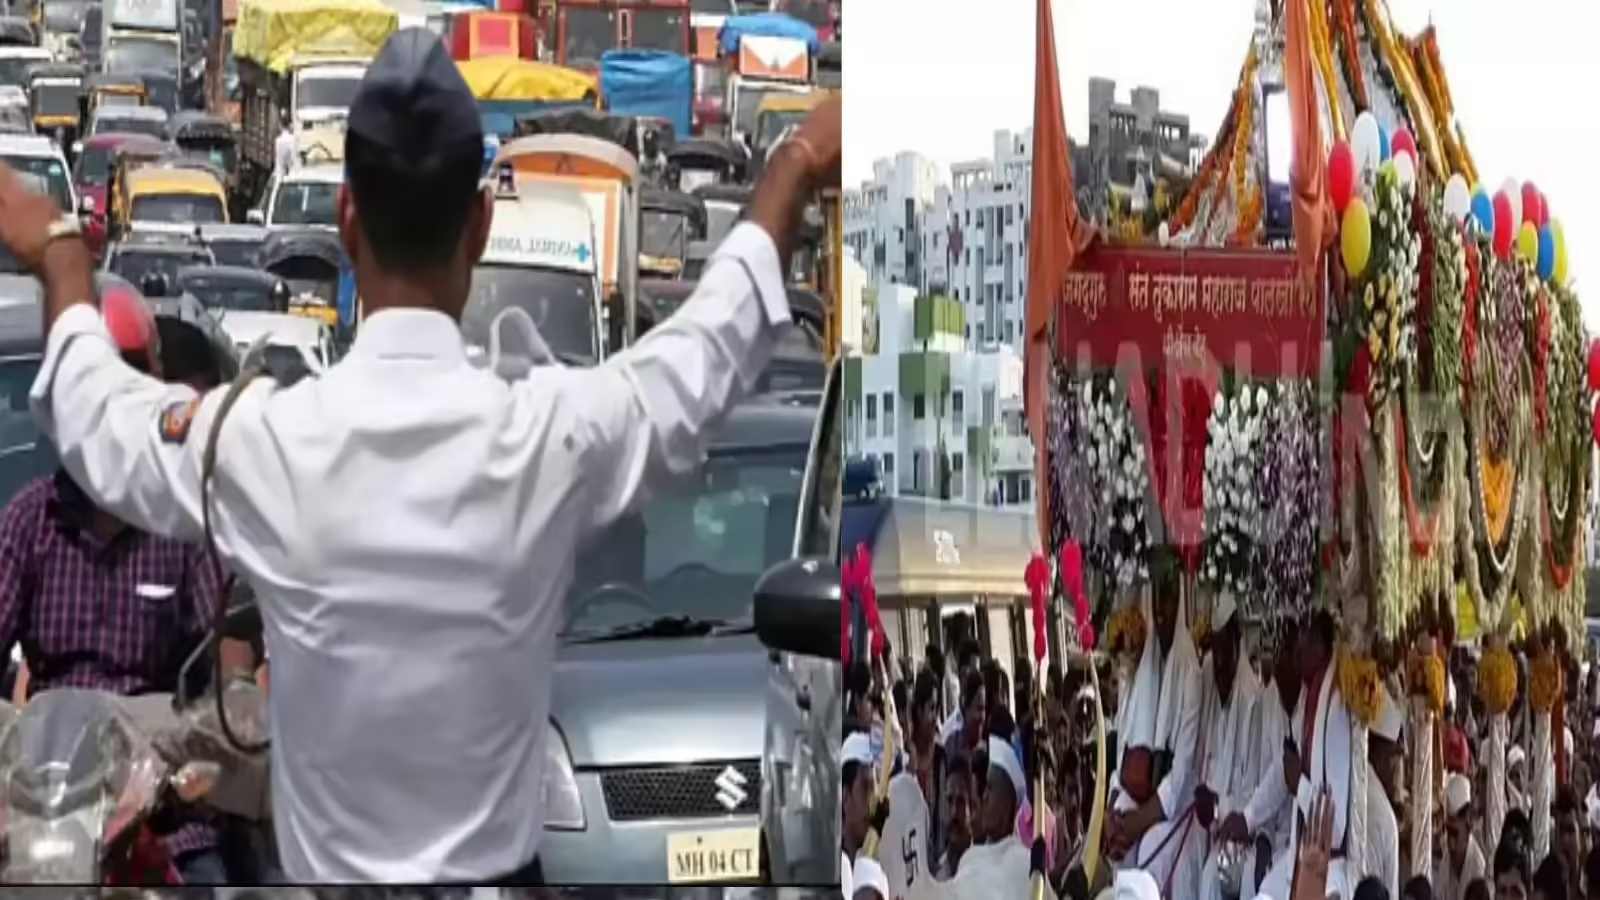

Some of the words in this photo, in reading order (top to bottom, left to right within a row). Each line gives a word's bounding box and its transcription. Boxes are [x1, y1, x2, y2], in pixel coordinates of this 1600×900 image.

[1128, 261, 1150, 312] संत
[1152, 273, 1197, 322] तुकाराम
[1202, 275, 1246, 319] महाराज
[676, 851, 704, 876] MH
[709, 849, 727, 873] 04
[730, 847, 752, 873] CT
